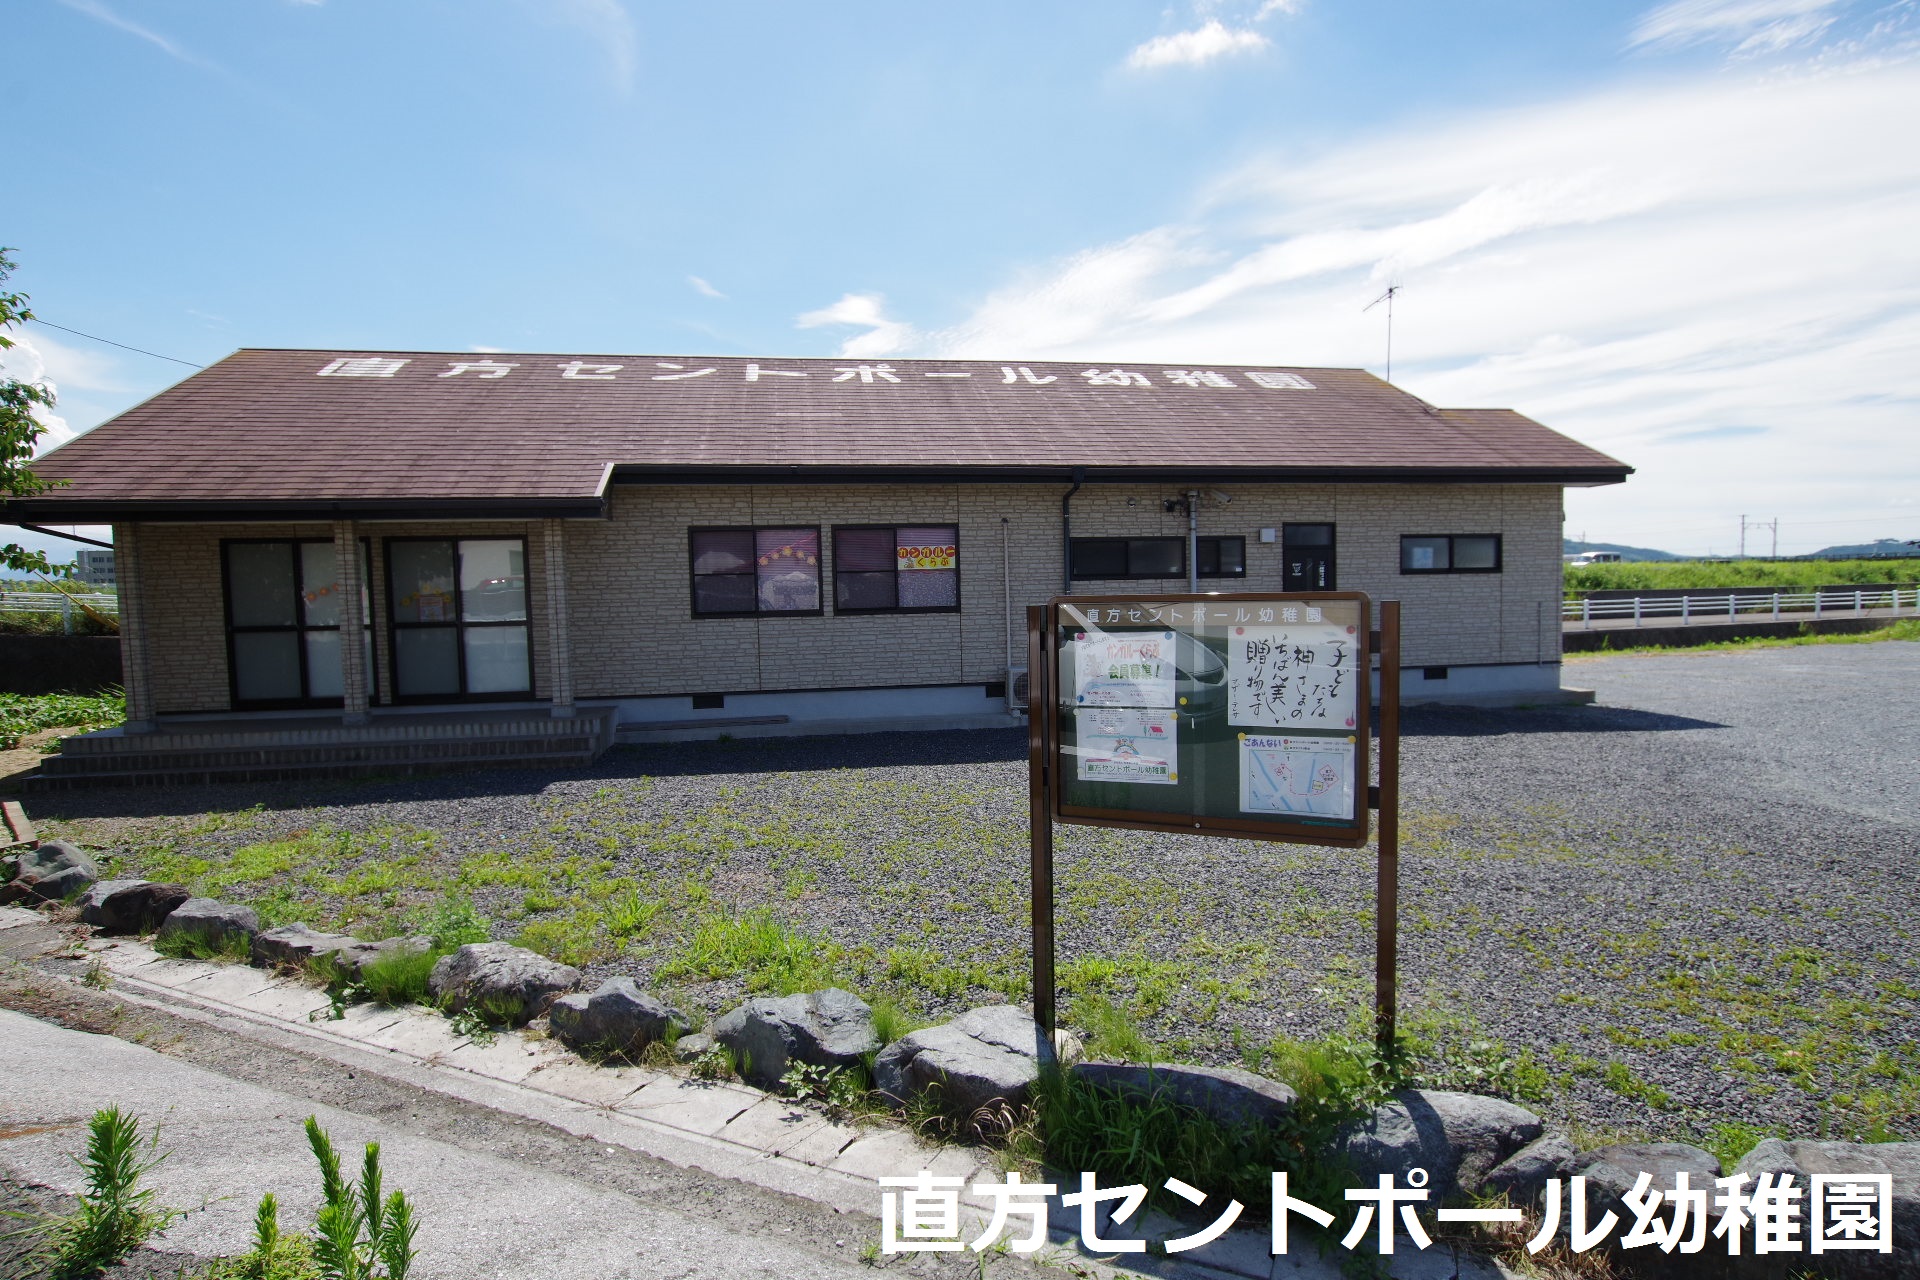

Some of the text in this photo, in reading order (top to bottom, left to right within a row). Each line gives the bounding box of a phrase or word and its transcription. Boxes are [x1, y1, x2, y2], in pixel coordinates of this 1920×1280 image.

[316, 357, 1317, 389] 直方セントポール幼稚園
[899, 547, 955, 558] カンガルー
[917, 557, 949, 567] くらぶ
[1086, 606, 1322, 623] 直方セントポール幼稚園
[1245, 639, 1271, 716] 贈り物です
[1265, 633, 1292, 725] いちばん美しい
[1291, 645, 1315, 720] 神さまの
[1243, 738, 1282, 748] ごあんない
